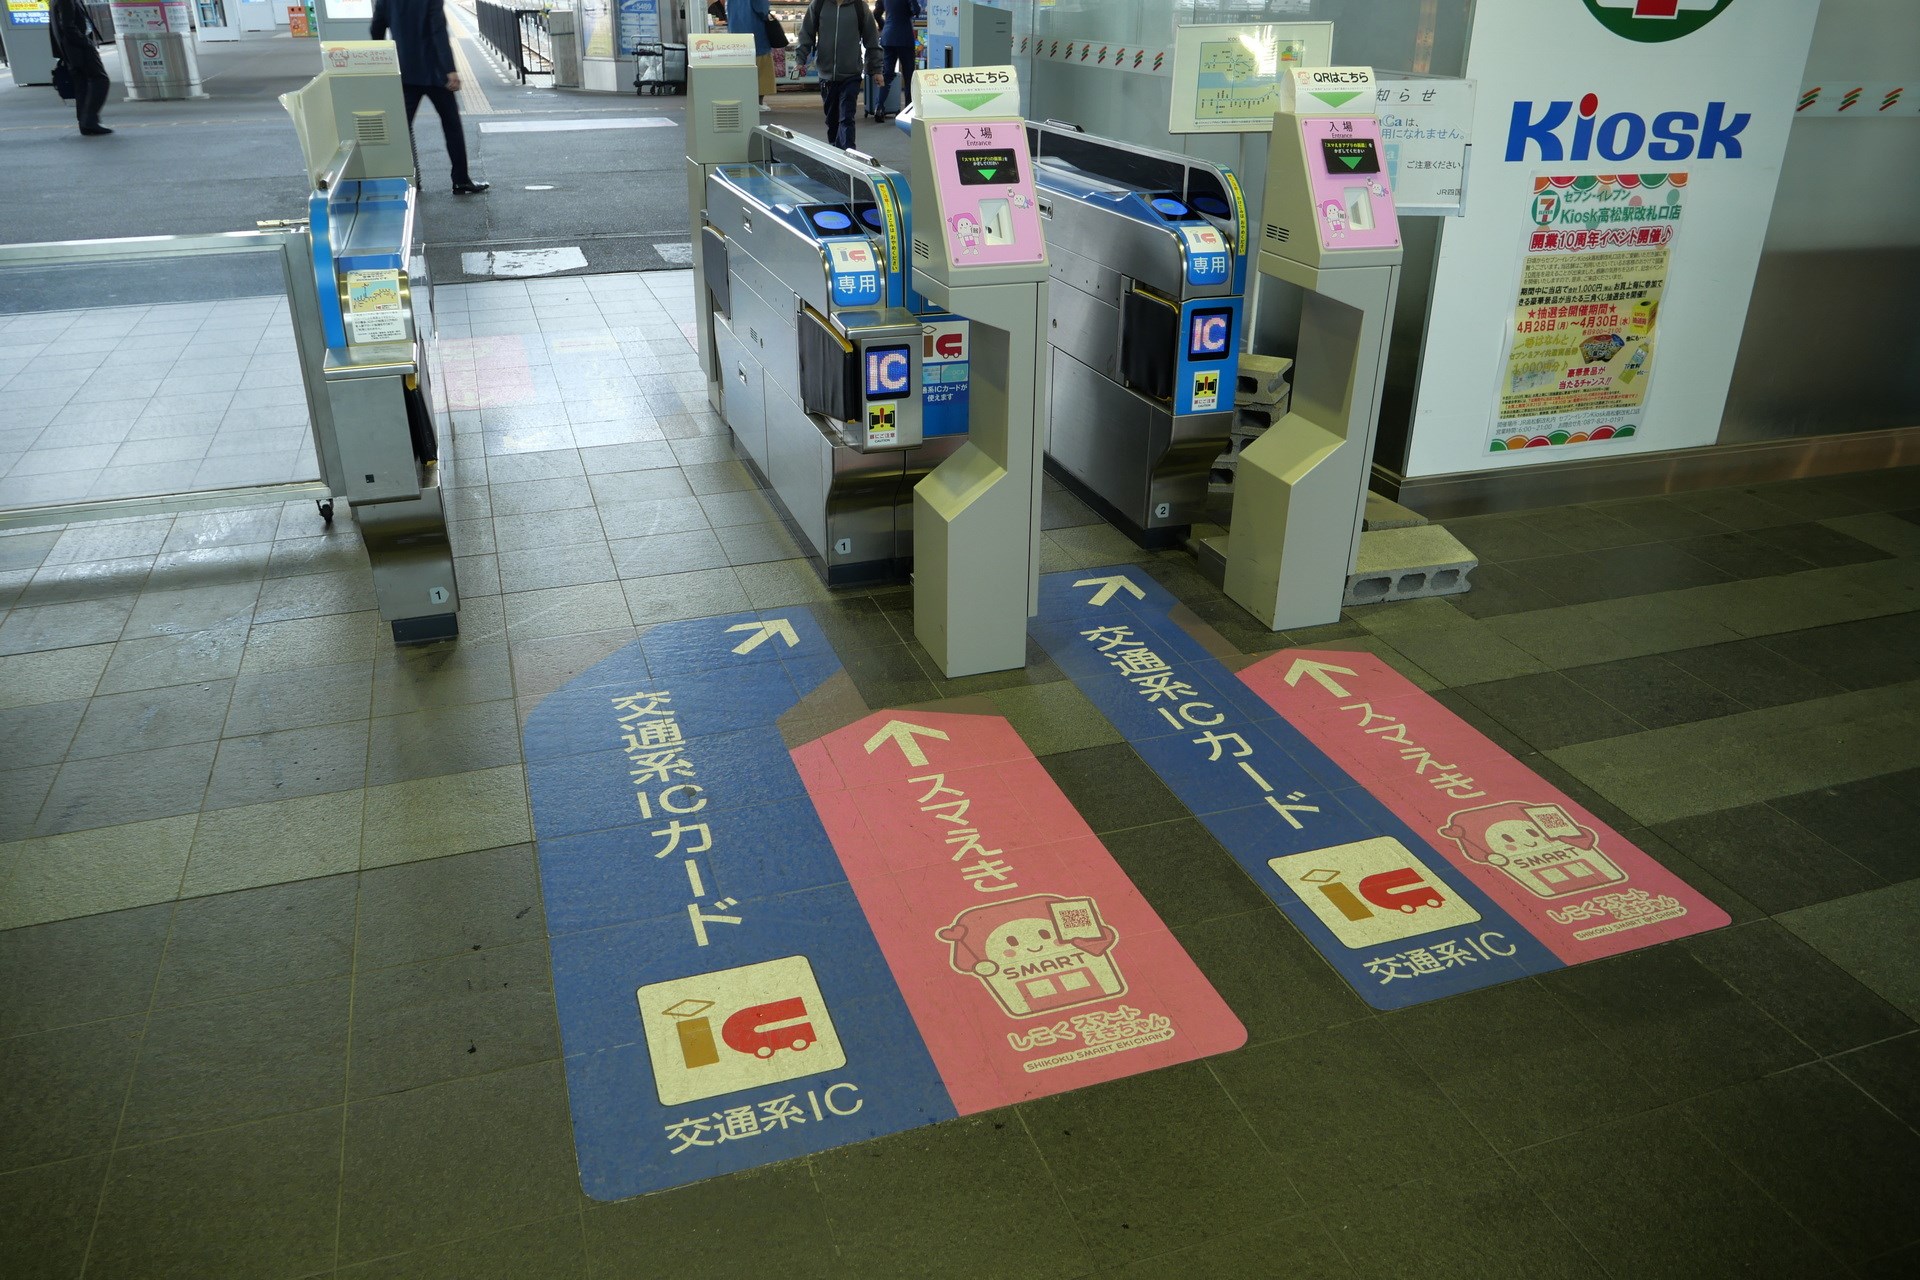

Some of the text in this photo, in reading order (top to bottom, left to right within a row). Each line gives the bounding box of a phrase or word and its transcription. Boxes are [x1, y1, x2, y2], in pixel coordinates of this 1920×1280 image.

[943, 71, 1010, 84] QRはこちら
[1313, 71, 1369, 83] QRはこちら
[964, 127, 993, 139] 入場
[1329, 121, 1353, 132] 入場
[1505, 93, 1752, 162] Kiosk
[1560, 205, 1683, 224] Kiosk高松駅改札口店
[1193, 256, 1226, 275] 専用
[837, 274, 876, 294] 専用
[1193, 317, 1226, 351] IC
[869, 353, 907, 391] IC
[927, 393, 954, 402] 使えます
[1160, 506, 1167, 515] 2
[841, 542, 847, 551] 1
[435, 590, 442, 600] 1
[1079, 625, 1320, 830] 交通系ICカード
[1339, 703, 1487, 800] スマえき
[611, 691, 743, 947] 交通系ICカード
[907, 773, 1019, 893] スマえき
[1513, 847, 1581, 869] SMART
[1576, 926, 1614, 939] SHIKOKU
[1615, 920, 1642, 930] SMART
[1003, 952, 1088, 980] SMART
[1362, 931, 1517, 985] 交通系IC
[1008, 1005, 1140, 1050] しこく スマート
[1084, 1014, 1169, 1044] えきちゃん
[1026, 1053, 1075, 1071] SHIKOKU
[1076, 1044, 1114, 1059] SMART
[664, 1082, 864, 1154] 交通系IC
